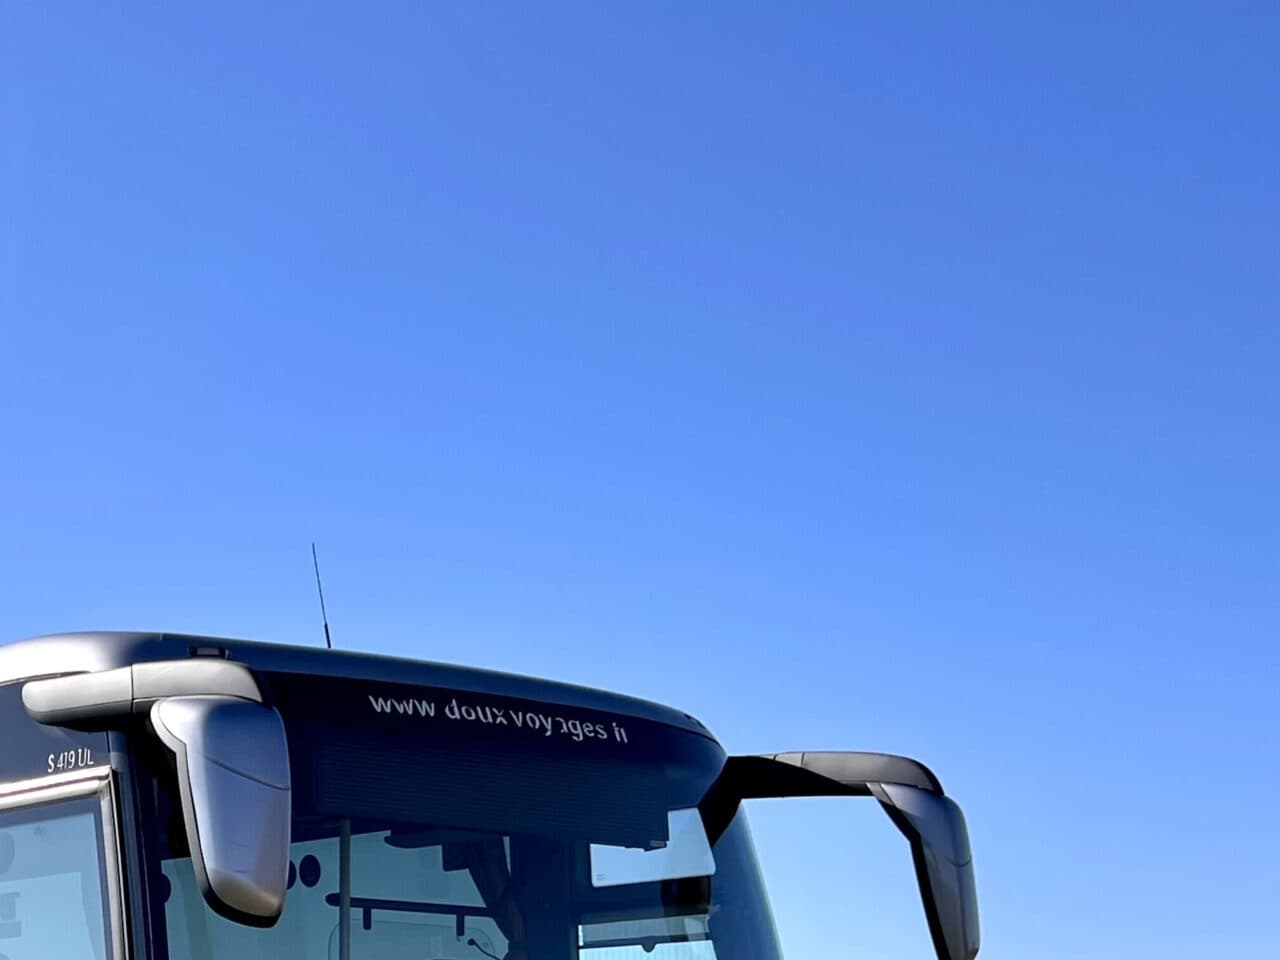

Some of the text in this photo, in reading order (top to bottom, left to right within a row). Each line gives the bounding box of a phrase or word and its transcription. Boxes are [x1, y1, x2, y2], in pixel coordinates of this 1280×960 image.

[47, 747, 95, 773] S 419 UL
